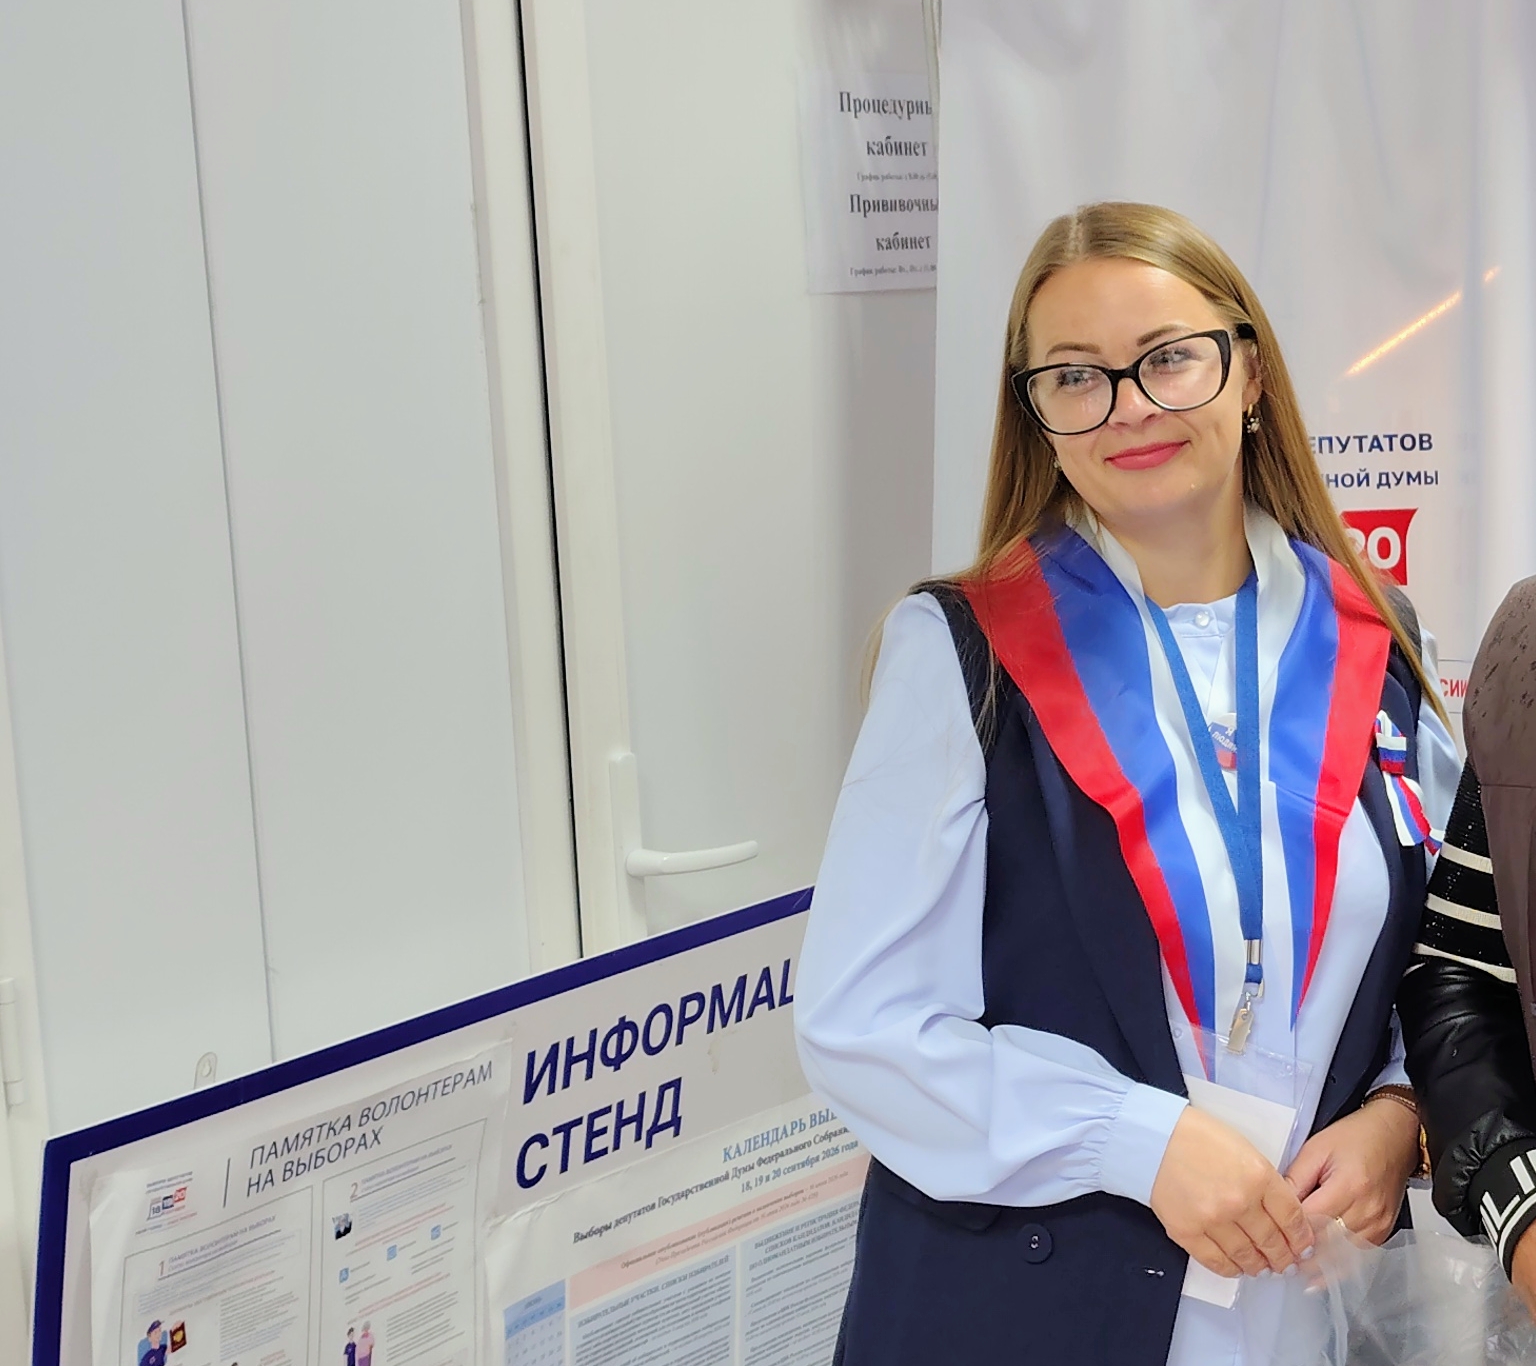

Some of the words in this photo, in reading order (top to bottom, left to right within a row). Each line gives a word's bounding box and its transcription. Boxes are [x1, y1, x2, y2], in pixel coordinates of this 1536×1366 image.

[839, 91, 932, 119] Процедурны
[867, 136, 927, 157] кабинет
[850, 193, 938, 218] Прививочны
[876, 232, 931, 251] кабинет
[1310, 434, 1433, 455] ЕПУТАТОВ
[1376, 470, 1439, 489] ДУМЫ
[250, 1115, 352, 1169] ПАМЯТКА
[358, 1061, 493, 1125] ВОЛОНТЕРАМ
[516, 1077, 683, 1189] СТЕНД
[722, 1117, 806, 1163] КАЛЕНДАРЬ
[247, 1167, 275, 1197] НА
[282, 1126, 384, 1181] ВЫБОРАХ
[754, 1175, 764, 1188] 19
[772, 1168, 782, 1182] 20
[782, 1153, 820, 1177] сентября
[350, 1182, 358, 1200] 2
[573, 1219, 613, 1244] Выборы
[613, 1202, 656, 1230] депутатов
[657, 1171, 730, 1209] Государственной
[731, 1161, 755, 1183] Думы
[756, 1140, 812, 1169] Федерального
[159, 1260, 164, 1276] 1
